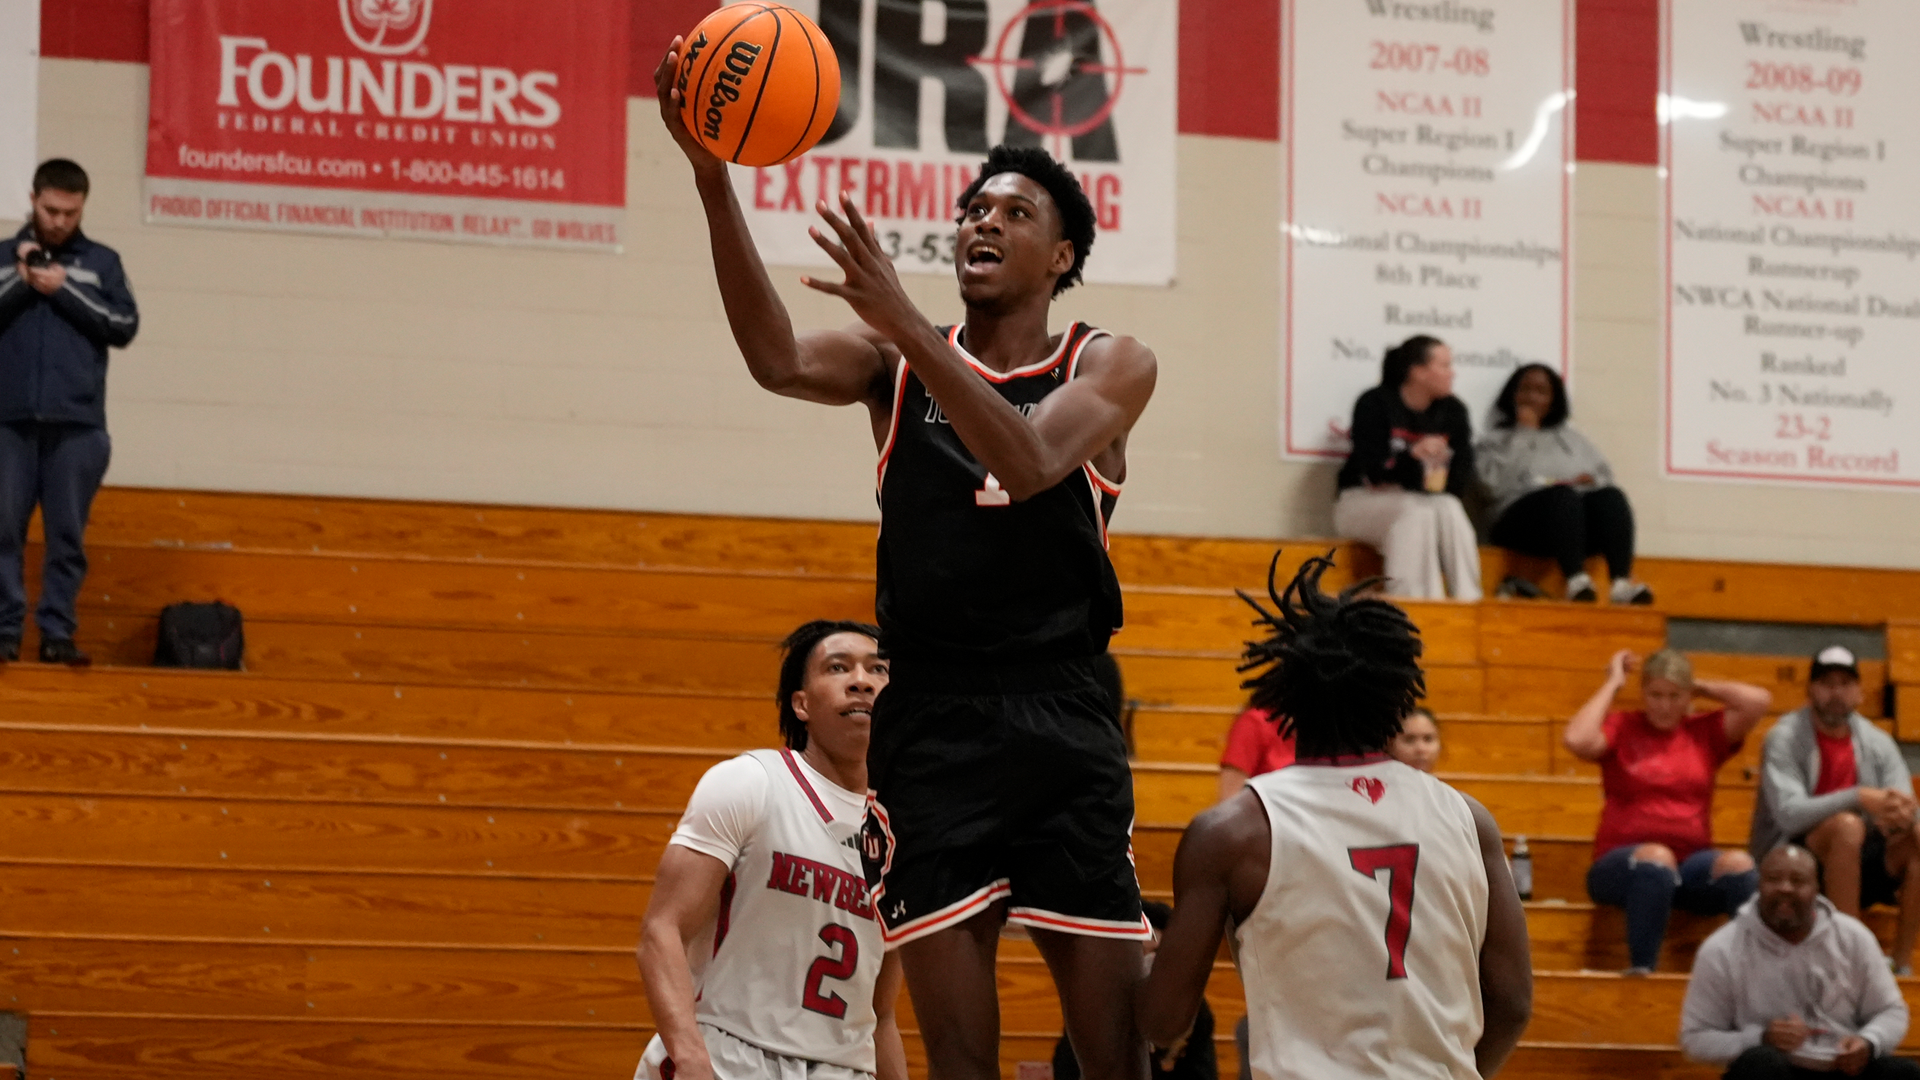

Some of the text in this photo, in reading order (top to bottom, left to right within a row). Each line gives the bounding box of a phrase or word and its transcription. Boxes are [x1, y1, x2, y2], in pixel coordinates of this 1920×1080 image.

[1366, 0, 1494, 33] Wrestling
[1740, 21, 1866, 59] Wrestling
[1369, 41, 1491, 76] 2007-08
[217, 35, 561, 128] FOUNDERS
[703, 40, 763, 141] Wilson
[1745, 60, 1863, 96] 2008-09
[1377, 91, 1483, 118] NCAA II
[1752, 101, 1854, 128] NCAA II
[217, 112, 556, 150] FEDERAL CREDIT UNION
[1341, 119, 1408, 148] Super
[1416, 124, 1498, 152] Region
[1719, 130, 1782, 158] Super
[1790, 134, 1871, 163] Region
[178, 143, 565, 190] foundersfcu.com 1-800-845-1614
[1362, 154, 1494, 186] Champions
[1739, 164, 1867, 194] Champions
[151, 194, 202, 219] PROUD
[206, 199, 271, 223] OFFICIAL
[277, 203, 355, 228] FINANCIAL
[361, 207, 455, 232] INSTITUTION
[1377, 192, 1483, 219] NCAA II
[1752, 194, 1854, 220] NCAA II
[1676, 219, 1765, 245] National
[1376, 263, 1480, 290] 8th Place
[1385, 303, 1473, 330] Ranked
[1676, 285, 1755, 310] NWCA
[1762, 289, 1861, 316] National
[1760, 352, 1846, 378] Ranked
[1778, 383, 1894, 417] Nationally
[1775, 413, 1832, 441] 23-2
[1706, 440, 1899, 472] Season Record
[767, 850, 875, 922] NEWBE
[1347, 843, 1420, 981] 7
[802, 922, 859, 1020] 2
